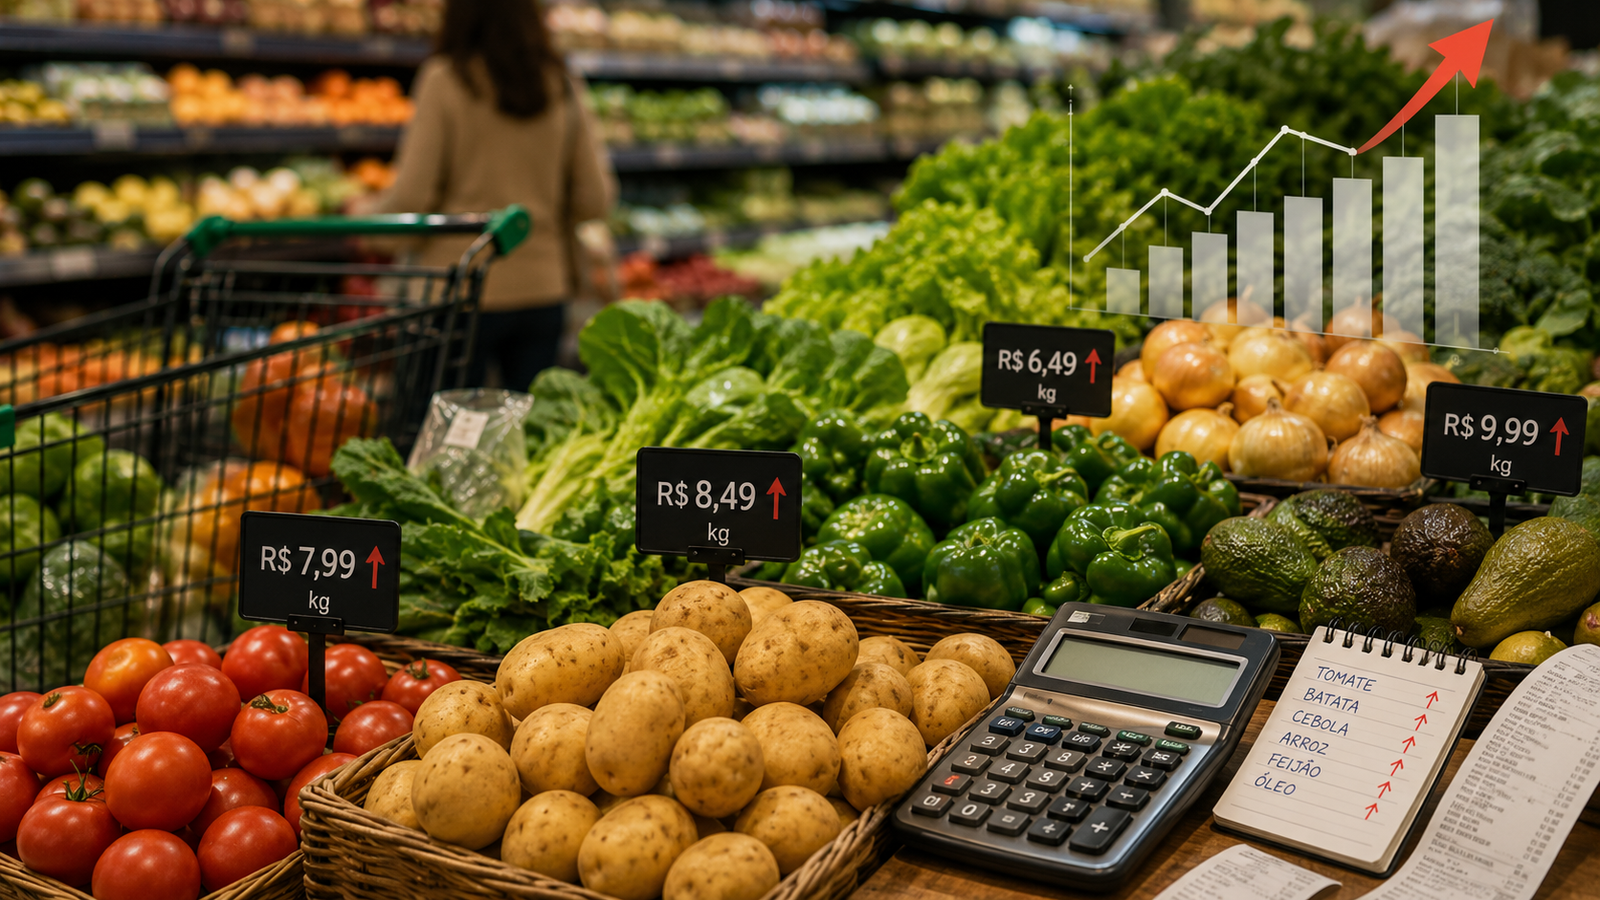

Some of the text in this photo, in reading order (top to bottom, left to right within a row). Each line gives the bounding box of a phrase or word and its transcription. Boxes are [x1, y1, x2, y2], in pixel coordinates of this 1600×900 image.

[997, 348, 1078, 378] R$ 6,49
[1037, 383, 1057, 404] kg
[1443, 412, 1539, 447] R$ 9,99
[1490, 453, 1512, 477] kg
[657, 479, 756, 514] R$ 8,49
[707, 522, 730, 547] kg
[260, 545, 356, 581] R$ 7,99
[308, 589, 330, 615] kg
[1316, 665, 1377, 692] TOMATE
[1303, 687, 1359, 714] BATATA
[1291, 709, 1349, 737] CEBOLA
[1278, 731, 1329, 756] ARROZ
[1001, 763, 1016, 774] 4
[1267, 752, 1321, 778] FEIJÃO
[980, 783, 997, 795] 3
[1254, 771, 1297, 796] ÓLEO
[1019, 792, 1036, 804] 3
